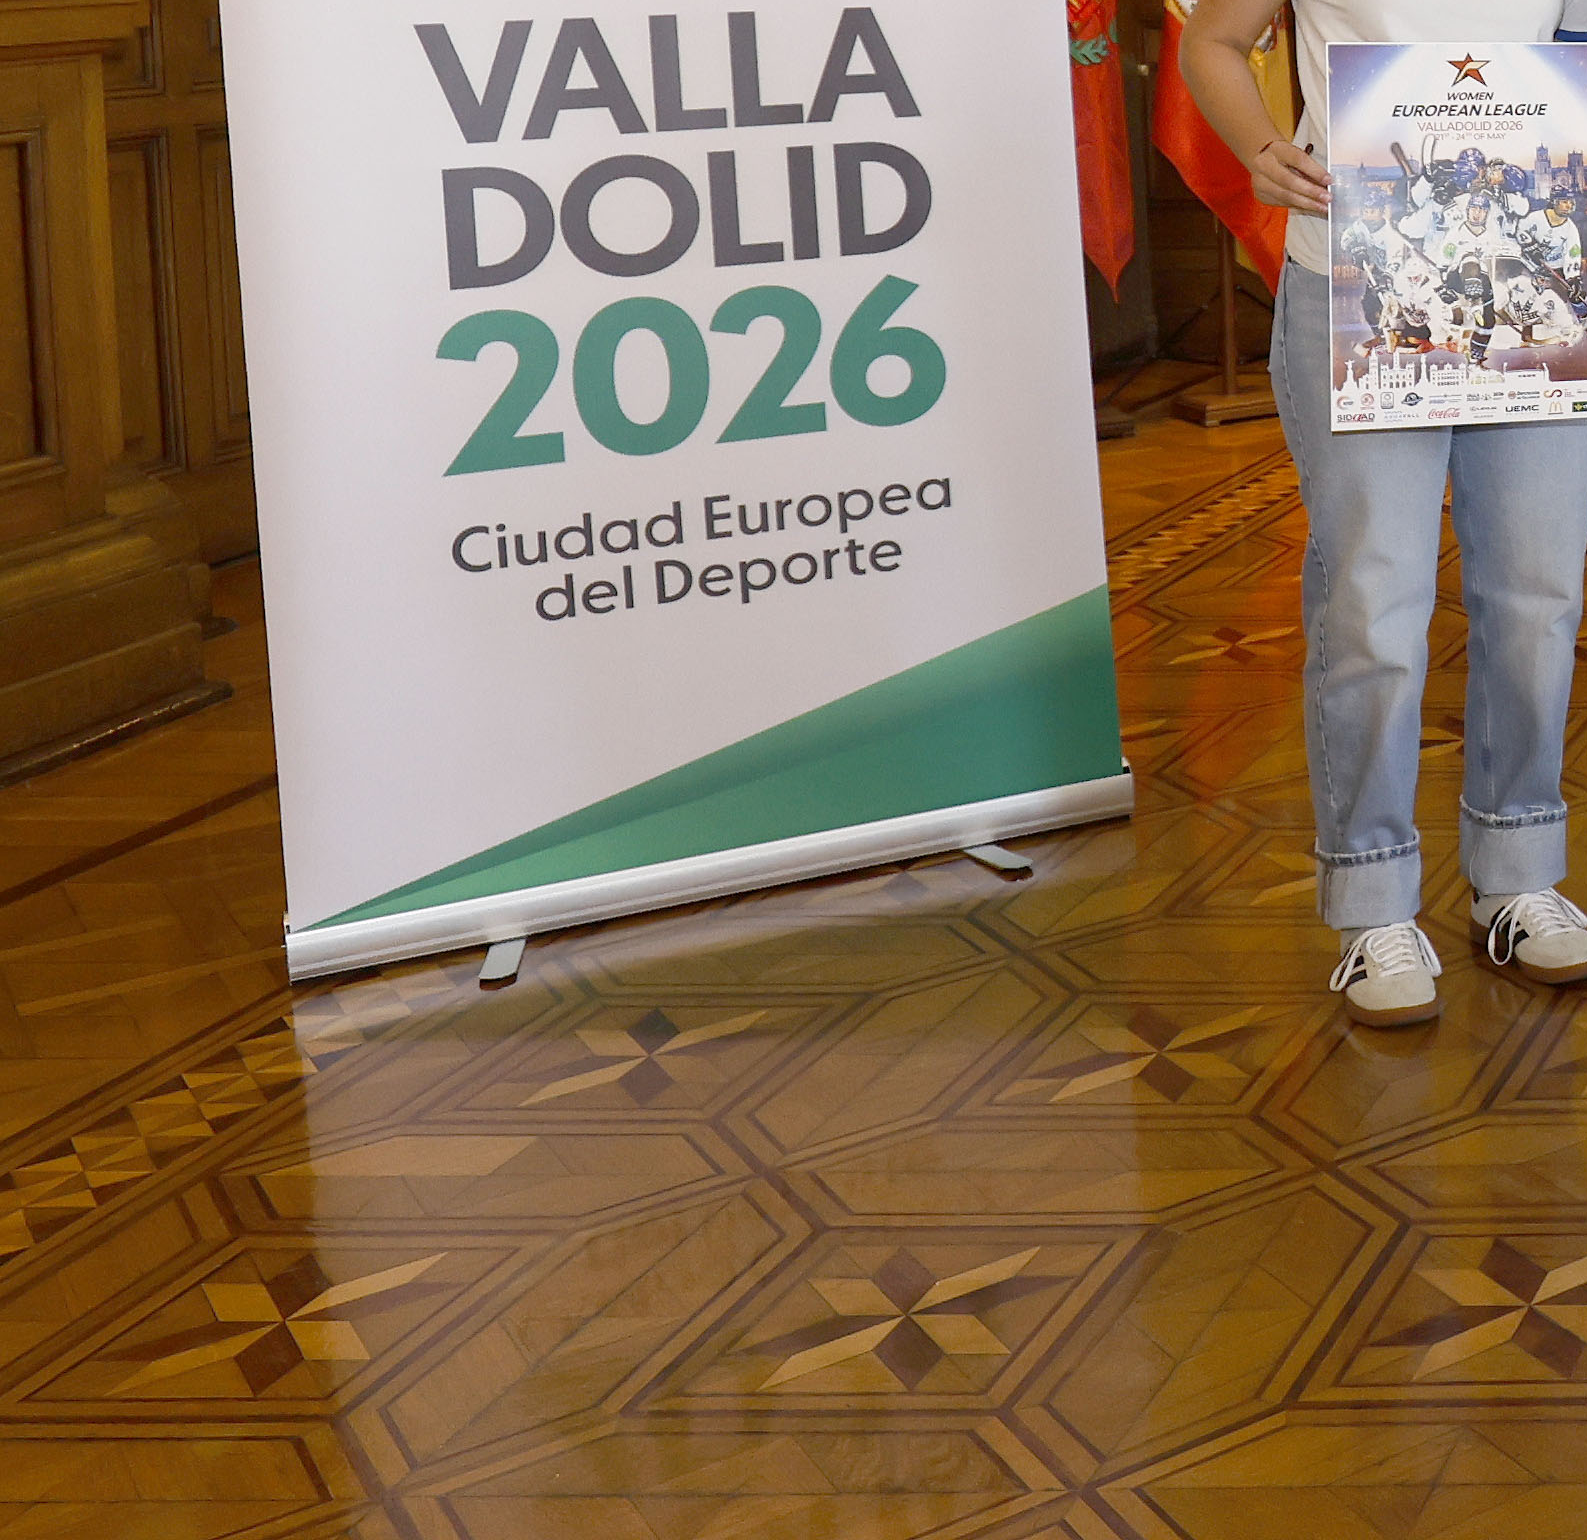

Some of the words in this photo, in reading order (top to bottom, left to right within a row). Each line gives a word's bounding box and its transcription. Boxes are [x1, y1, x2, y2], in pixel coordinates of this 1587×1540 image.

[414, 7, 920, 144] VALLA
[1446, 92, 1494, 101] WOMEN
[1392, 104, 1482, 117] EUROPEAN
[1484, 103, 1548, 116] LEAGUE
[1417, 121, 1492, 131] VALLADOLID
[1494, 120, 1524, 131] 2026
[1487, 132, 1506, 140] MAY
[442, 142, 933, 291] DOLID
[437, 275, 947, 477] 2026
[1505, 404, 1540, 413] UEMC
[451, 502, 683, 575] Ciudad
[704, 474, 953, 559] Europea
[535, 549, 635, 621] del
[655, 535, 903, 609] Deporte
